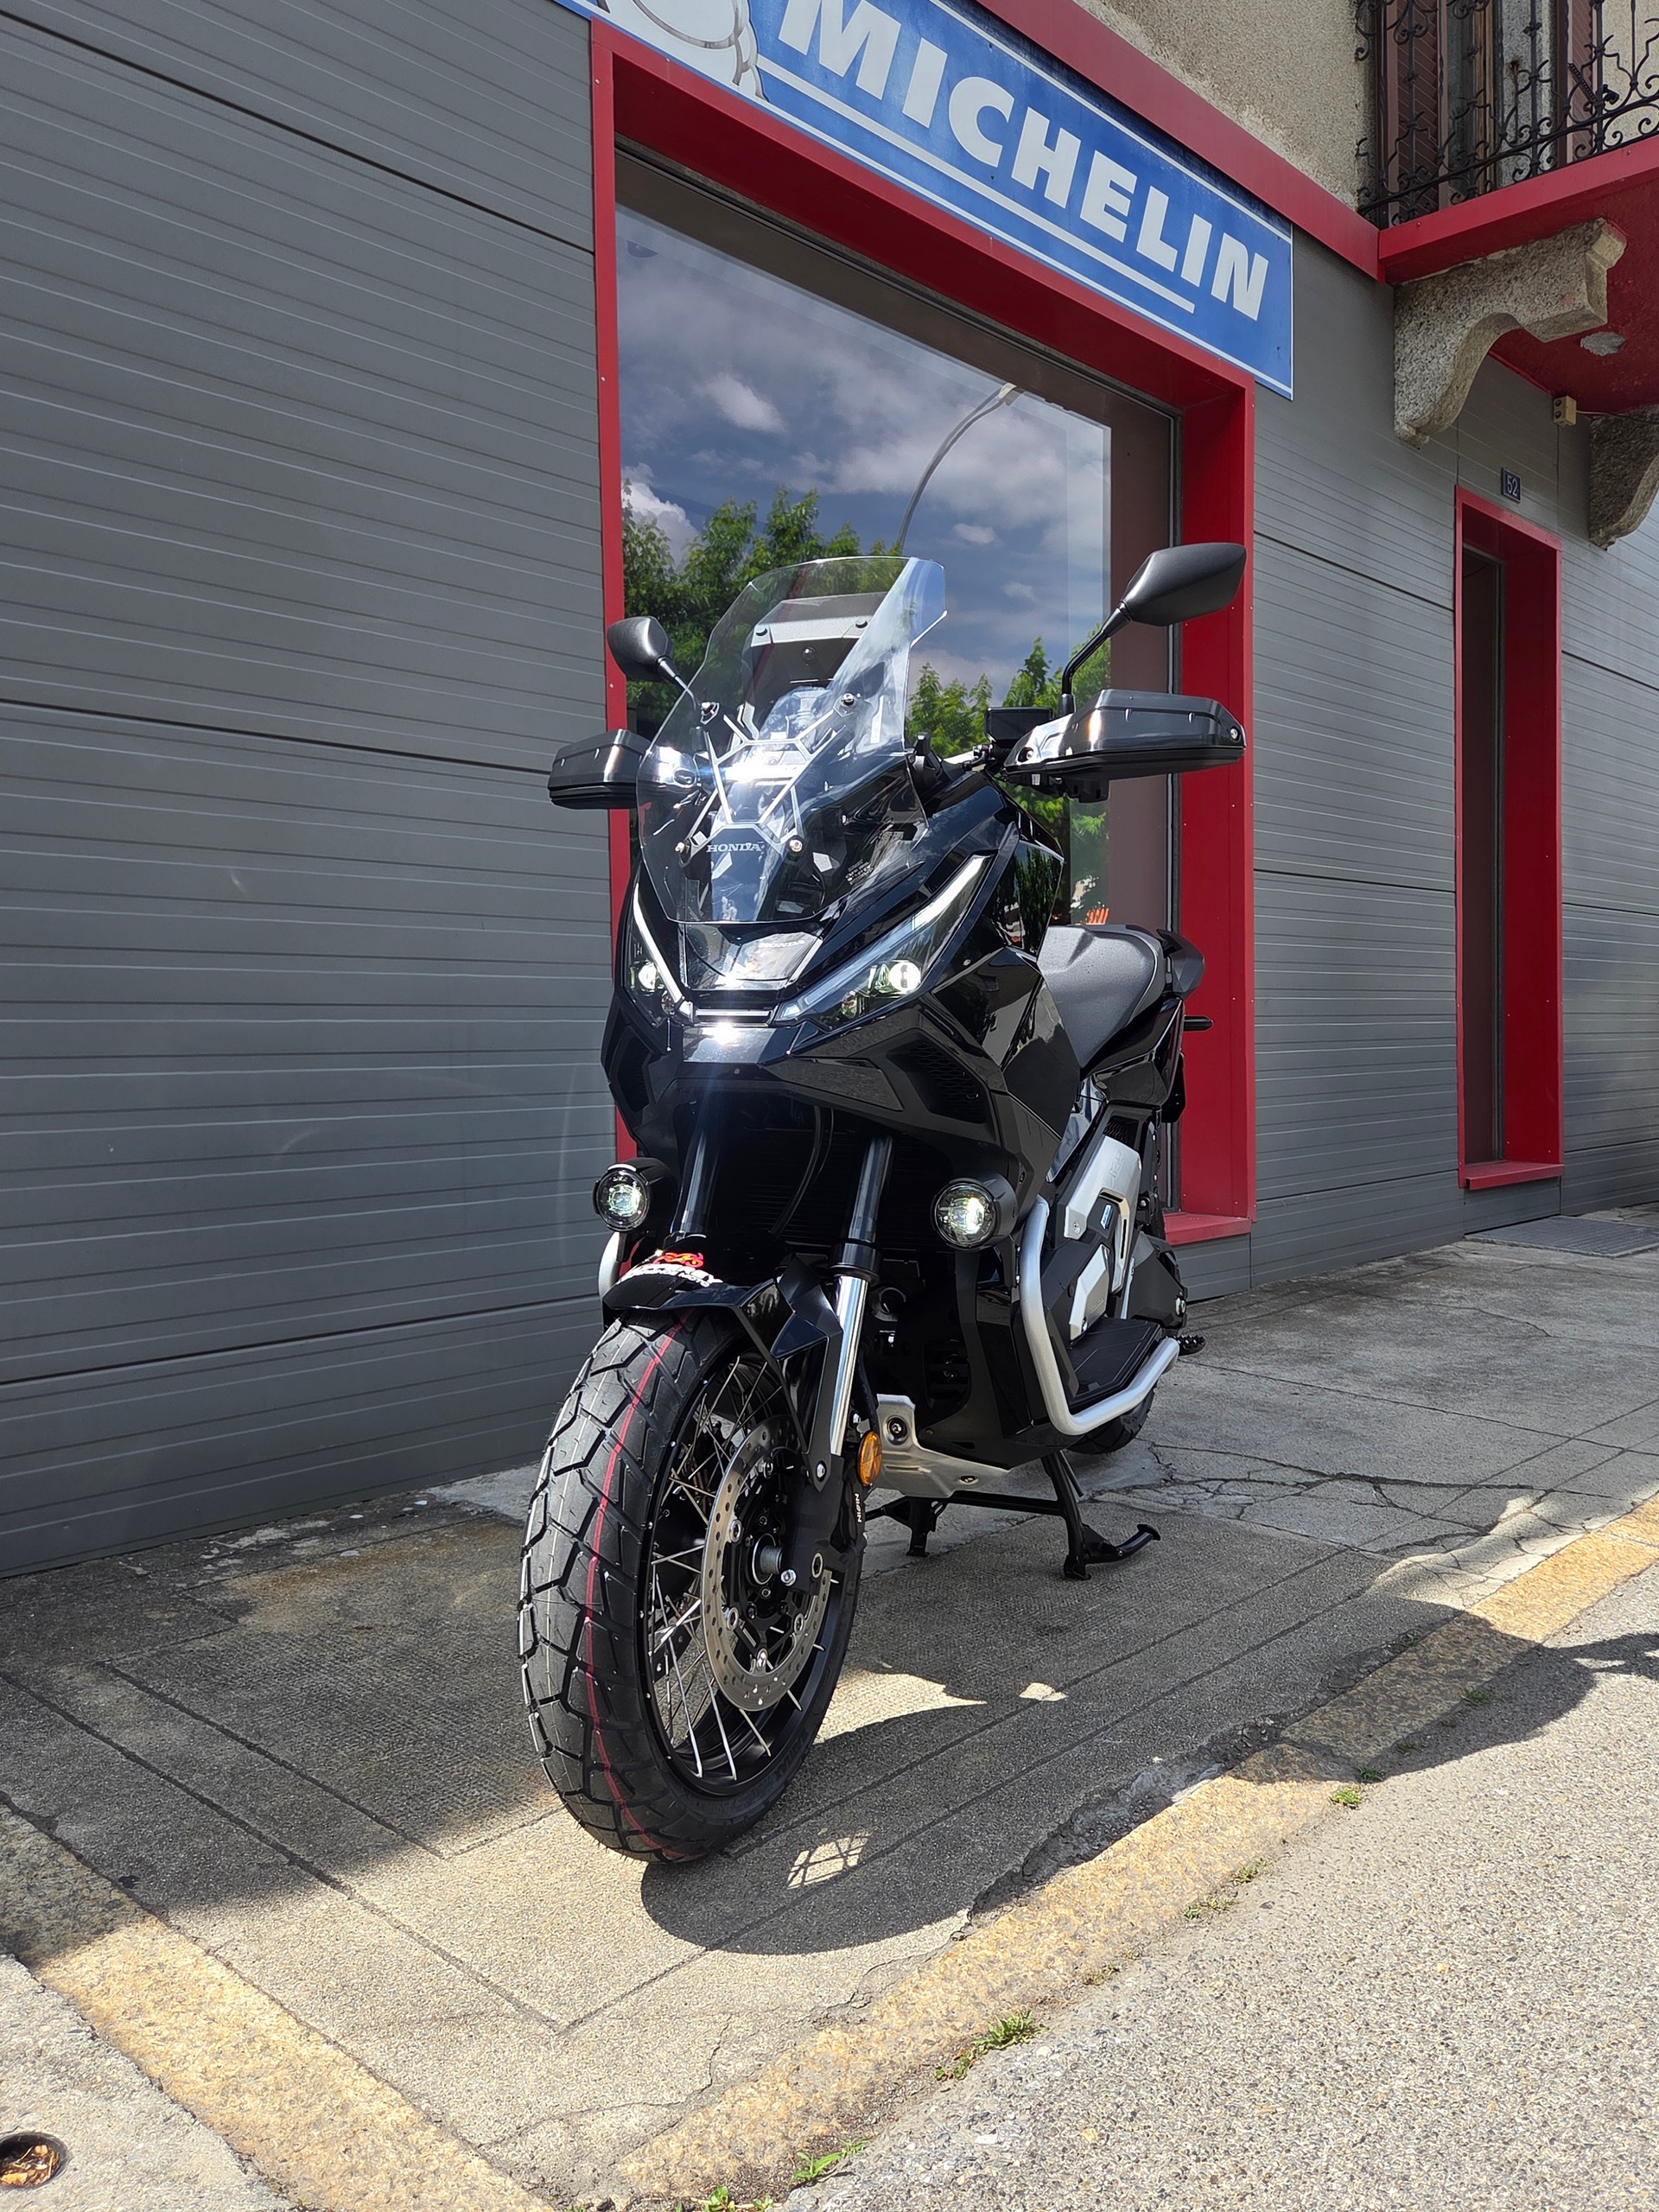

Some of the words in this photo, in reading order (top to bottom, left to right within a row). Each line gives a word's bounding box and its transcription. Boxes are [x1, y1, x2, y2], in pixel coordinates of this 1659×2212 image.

[778, 0, 1270, 321] MICHELIN
[1507, 474, 1518, 497] 52
[706, 842, 762, 853] HONDA
